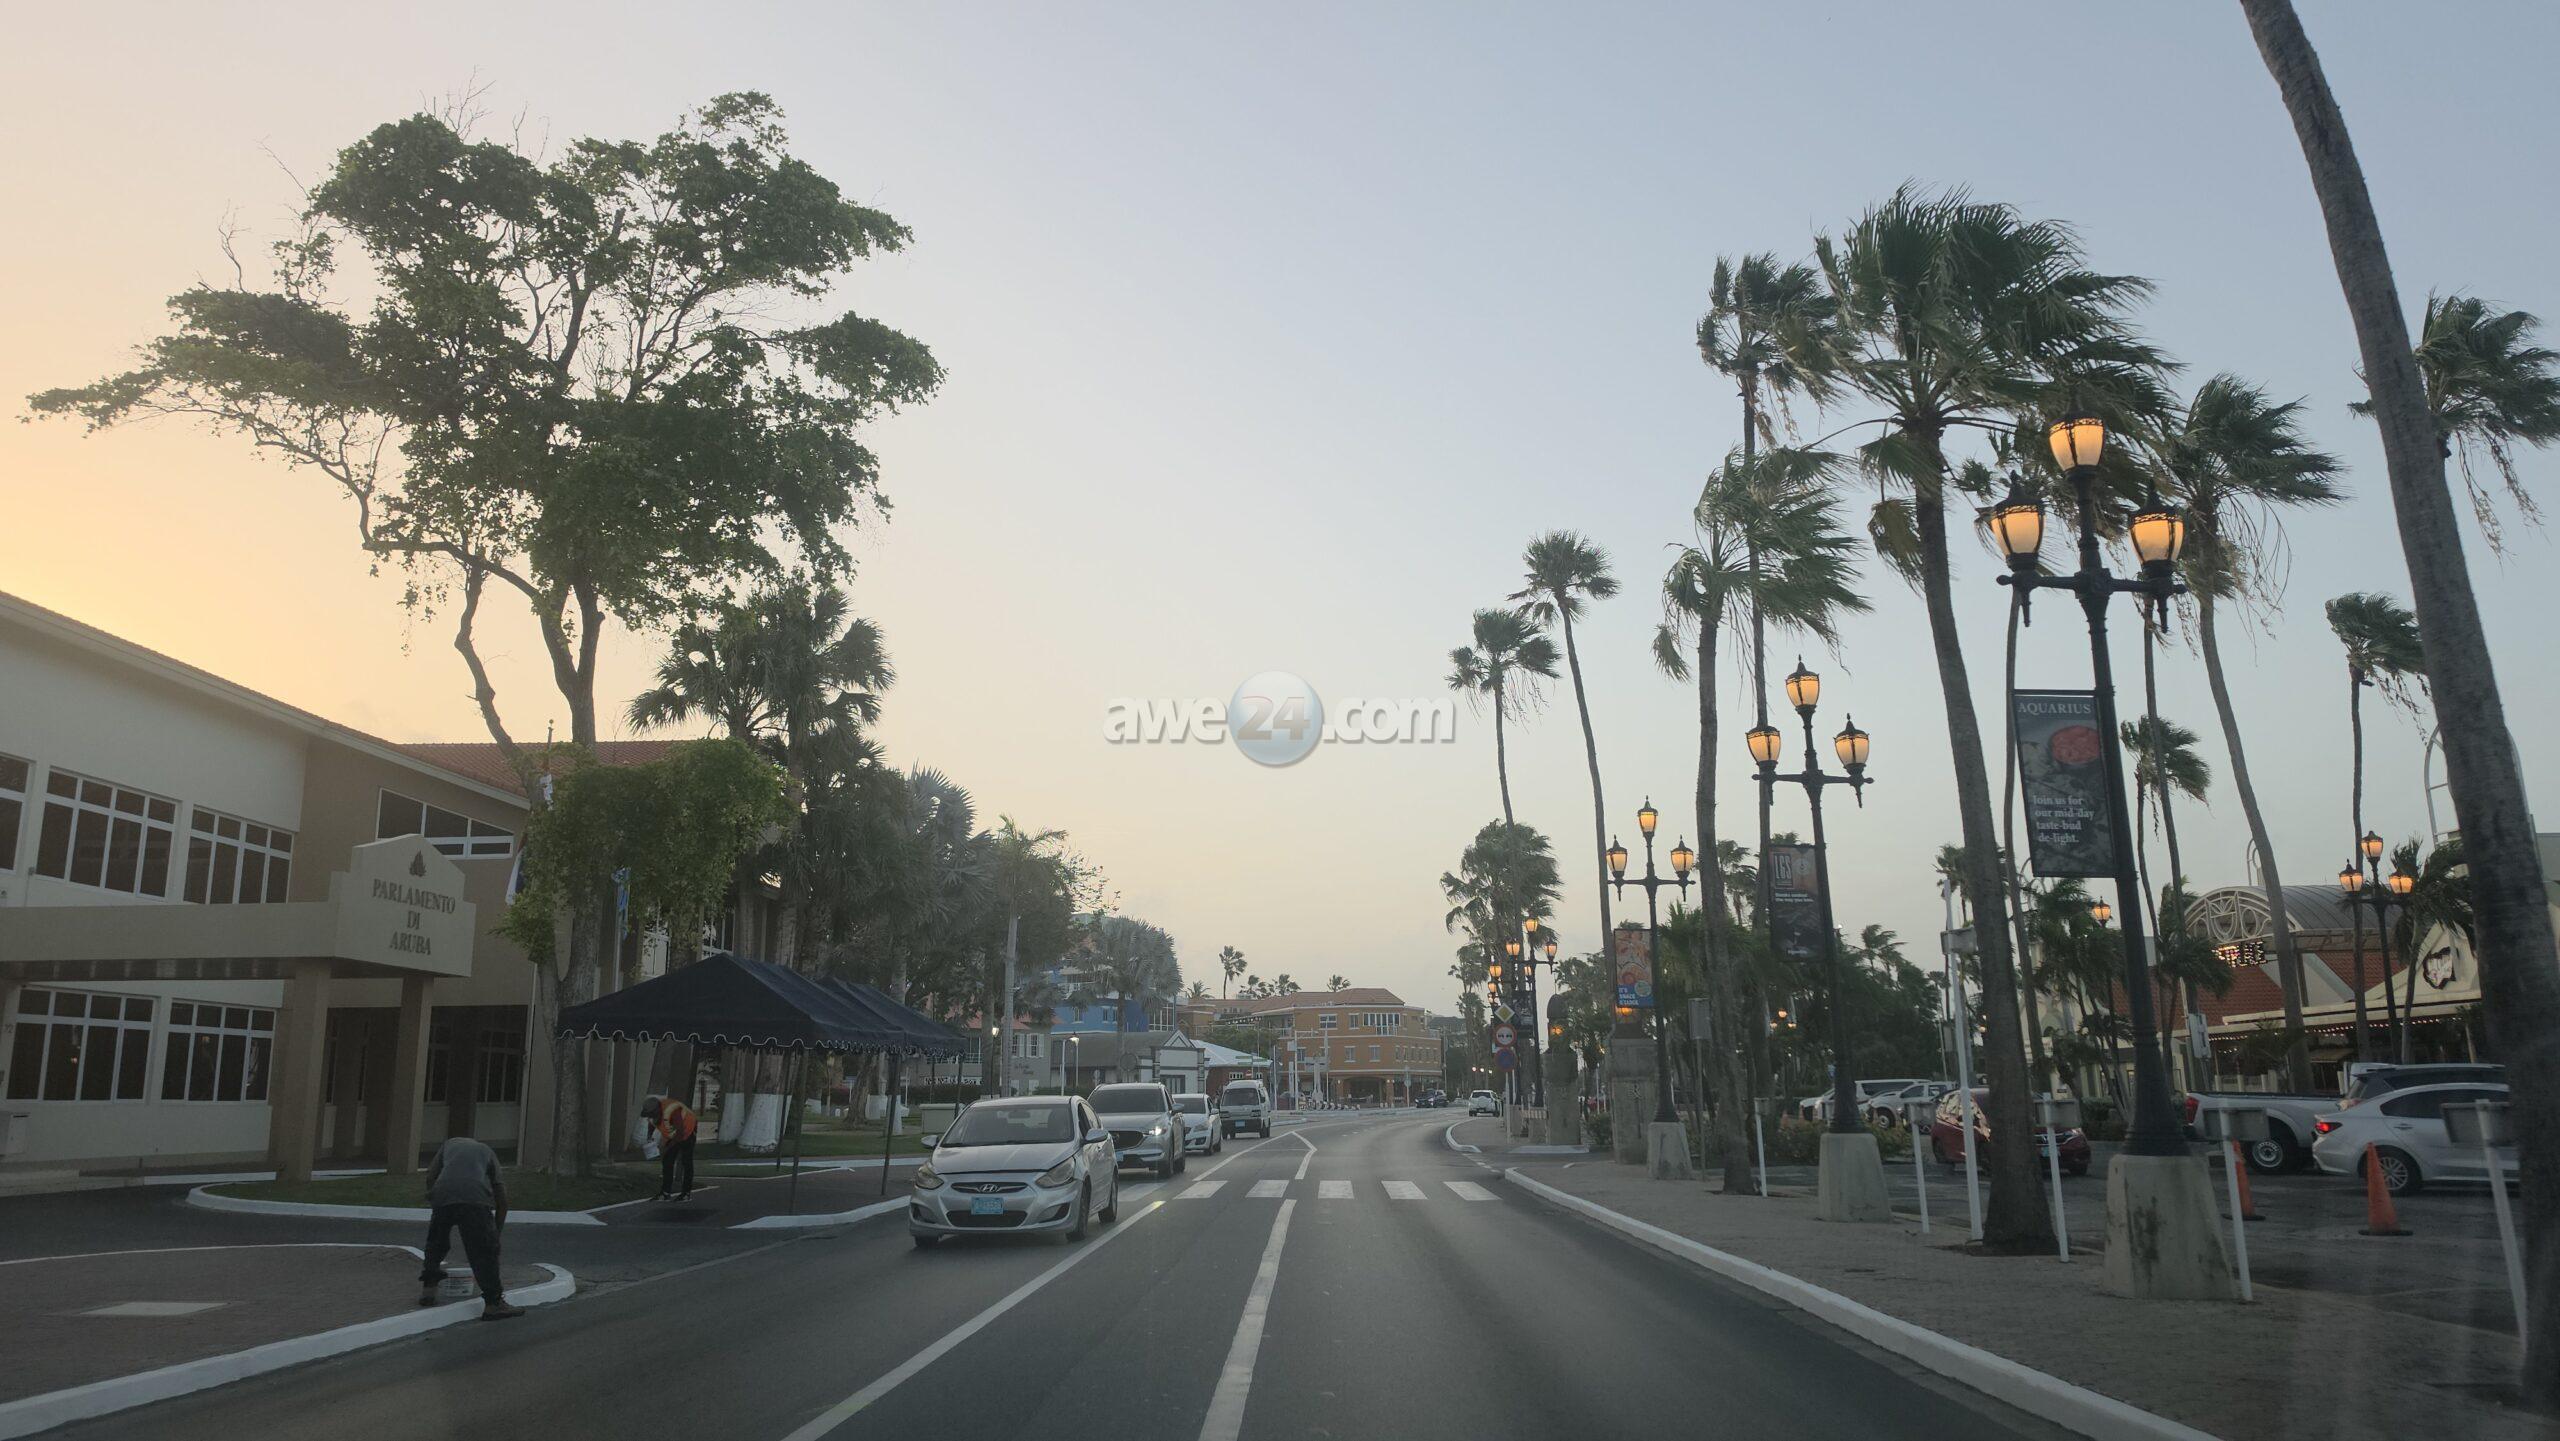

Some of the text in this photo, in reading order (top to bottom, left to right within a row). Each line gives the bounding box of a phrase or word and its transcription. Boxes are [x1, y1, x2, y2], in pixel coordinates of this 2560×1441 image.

[2017, 702, 2092, 715] AQUARIUS
[2033, 795, 2084, 805] Join us for
[2054, 807, 2095, 821] mid-day
[2036, 819, 2082, 830] taste-bud
[1774, 855, 1792, 879] LGS
[372, 878, 456, 914] PARLAMENTO
[406, 910, 420, 930] DI
[389, 931, 432, 956] ARUBA
